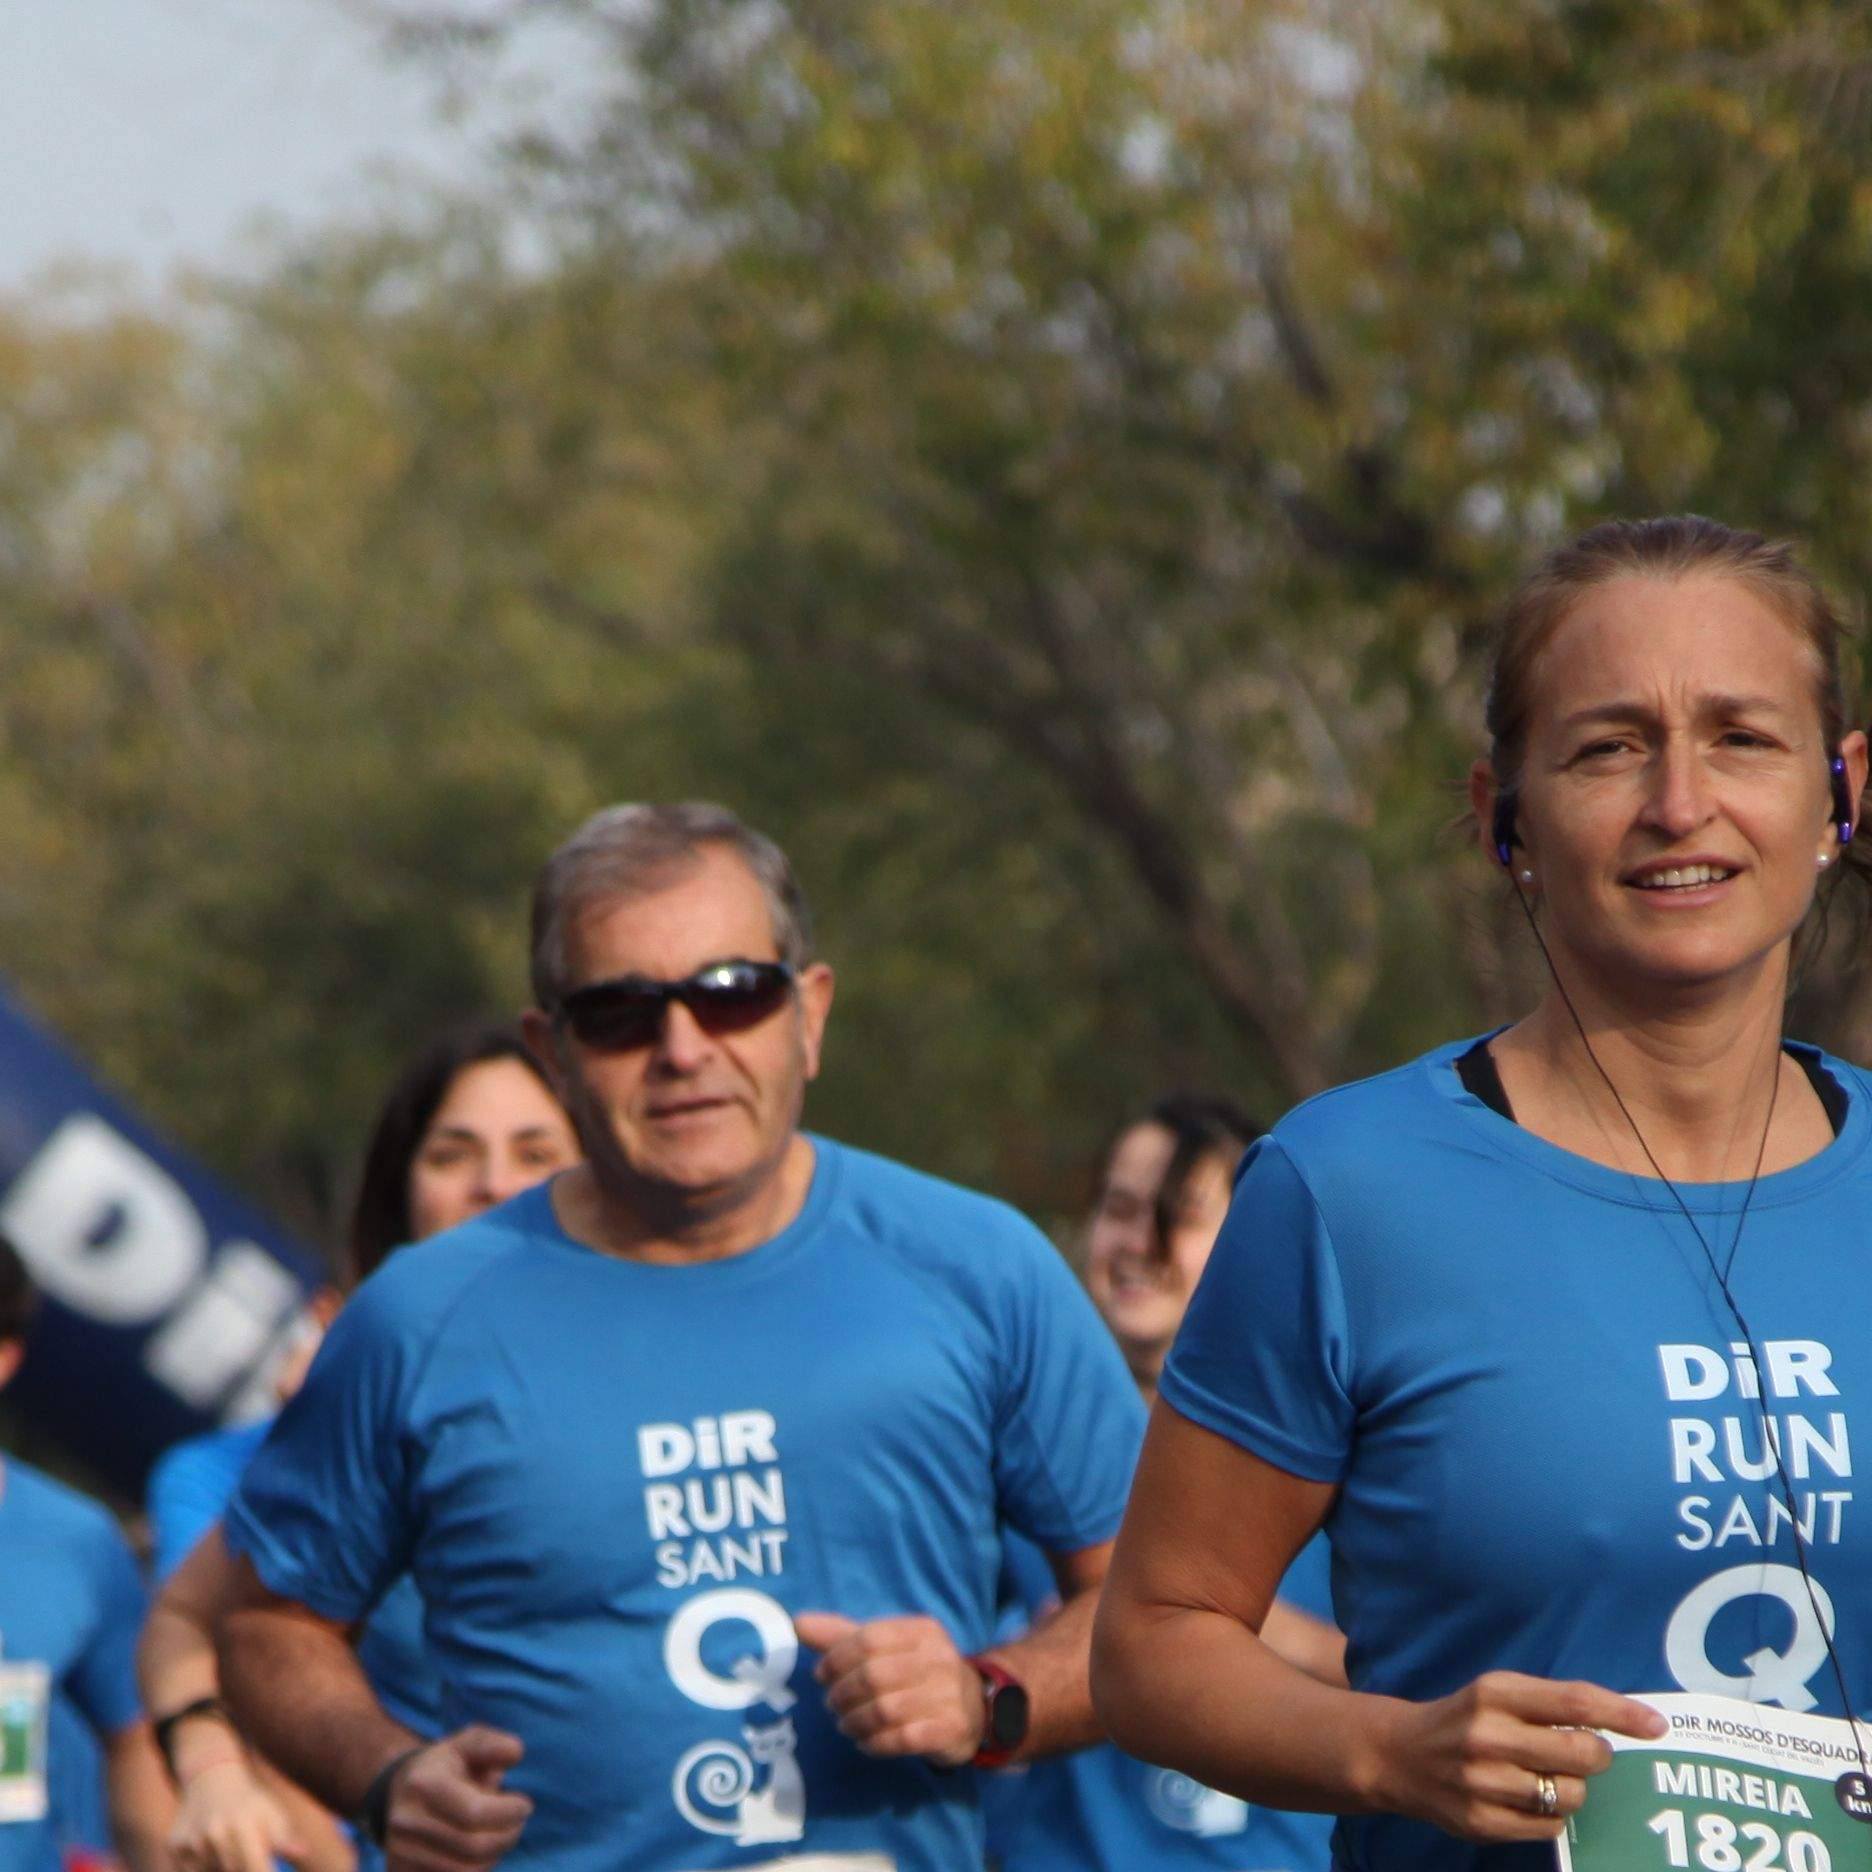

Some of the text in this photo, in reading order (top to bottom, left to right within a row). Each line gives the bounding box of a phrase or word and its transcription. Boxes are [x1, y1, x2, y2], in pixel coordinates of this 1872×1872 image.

[1658, 1340, 1840, 1401] DiR
[638, 1409, 778, 1478] DiR
[1671, 1411, 1853, 1483] RUN
[644, 1467, 786, 1541] RUN
[1676, 1491, 1853, 1551] SANT
[655, 1528, 788, 1589] SANT
[662, 1585, 799, 1713] Q
[1665, 1562, 1835, 1713] Q
[1707, 1718, 1773, 1744] MOSSOS
[1652, 1761, 1812, 1819] MIREIA
